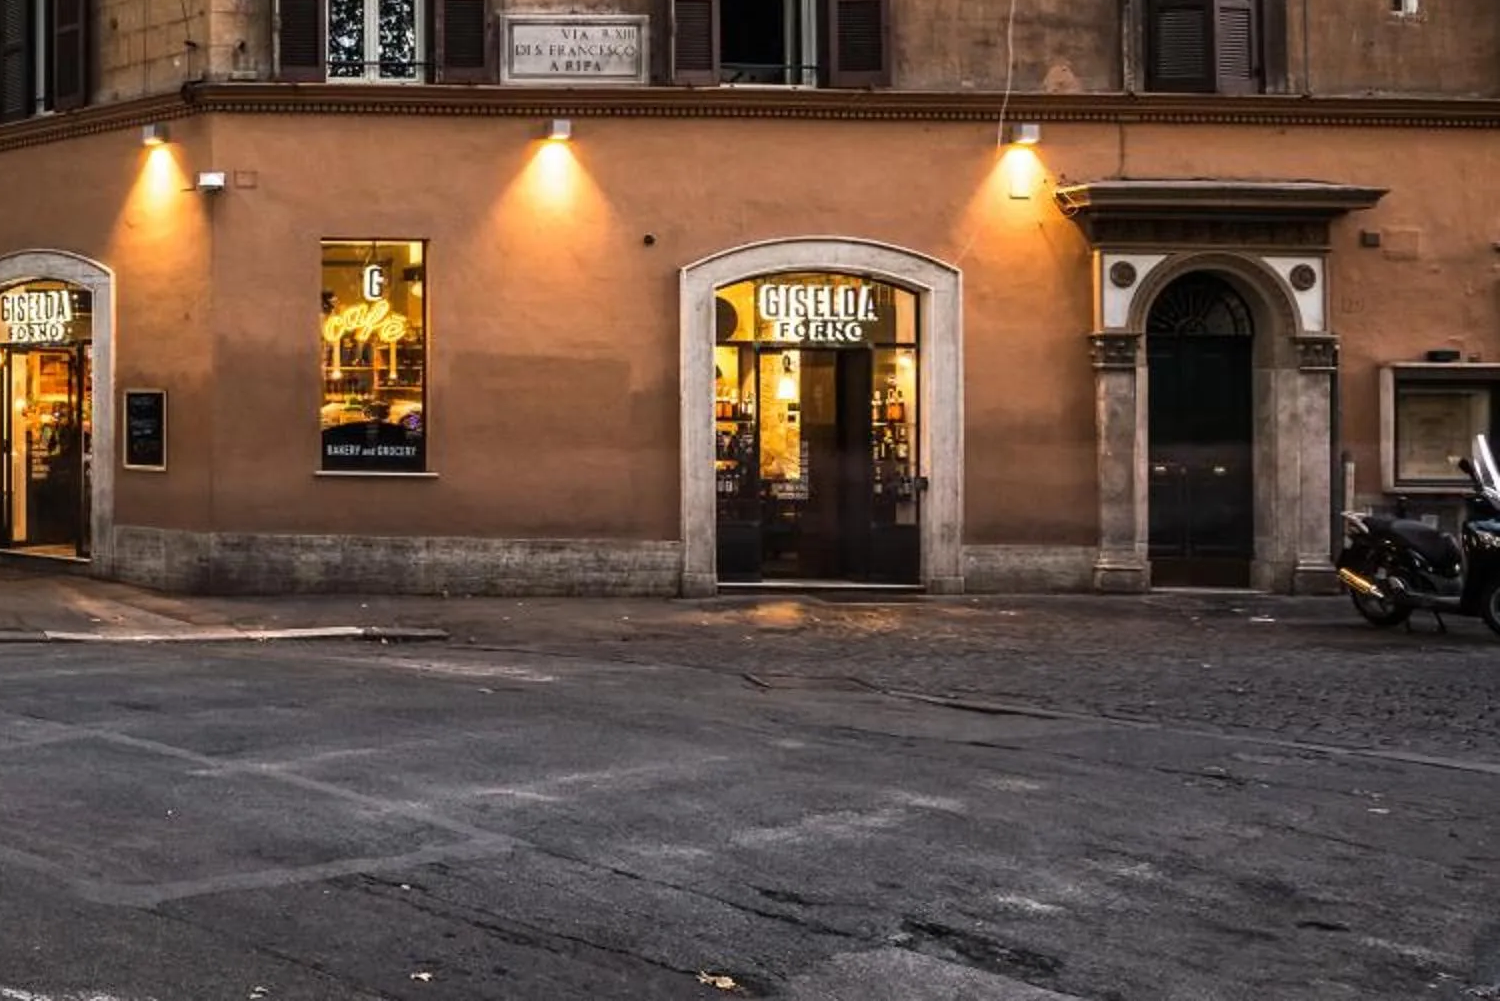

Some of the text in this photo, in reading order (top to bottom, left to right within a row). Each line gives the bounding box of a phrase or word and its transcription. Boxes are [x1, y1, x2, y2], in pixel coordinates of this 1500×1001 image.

[561, 28, 589, 40] VIA
[515, 44, 531, 56] DI
[549, 44, 635, 57] FRANCESCO
[550, 60, 601, 72] A RIPA
[364, 265, 385, 301] G
[1, 290, 74, 323] GISELDA
[759, 284, 878, 321] GISELDA
[8, 324, 65, 341] FORNO
[775, 321, 862, 341] FORNO
[327, 444, 361, 456] BAKERY
[377, 444, 417, 456] GROCERY
